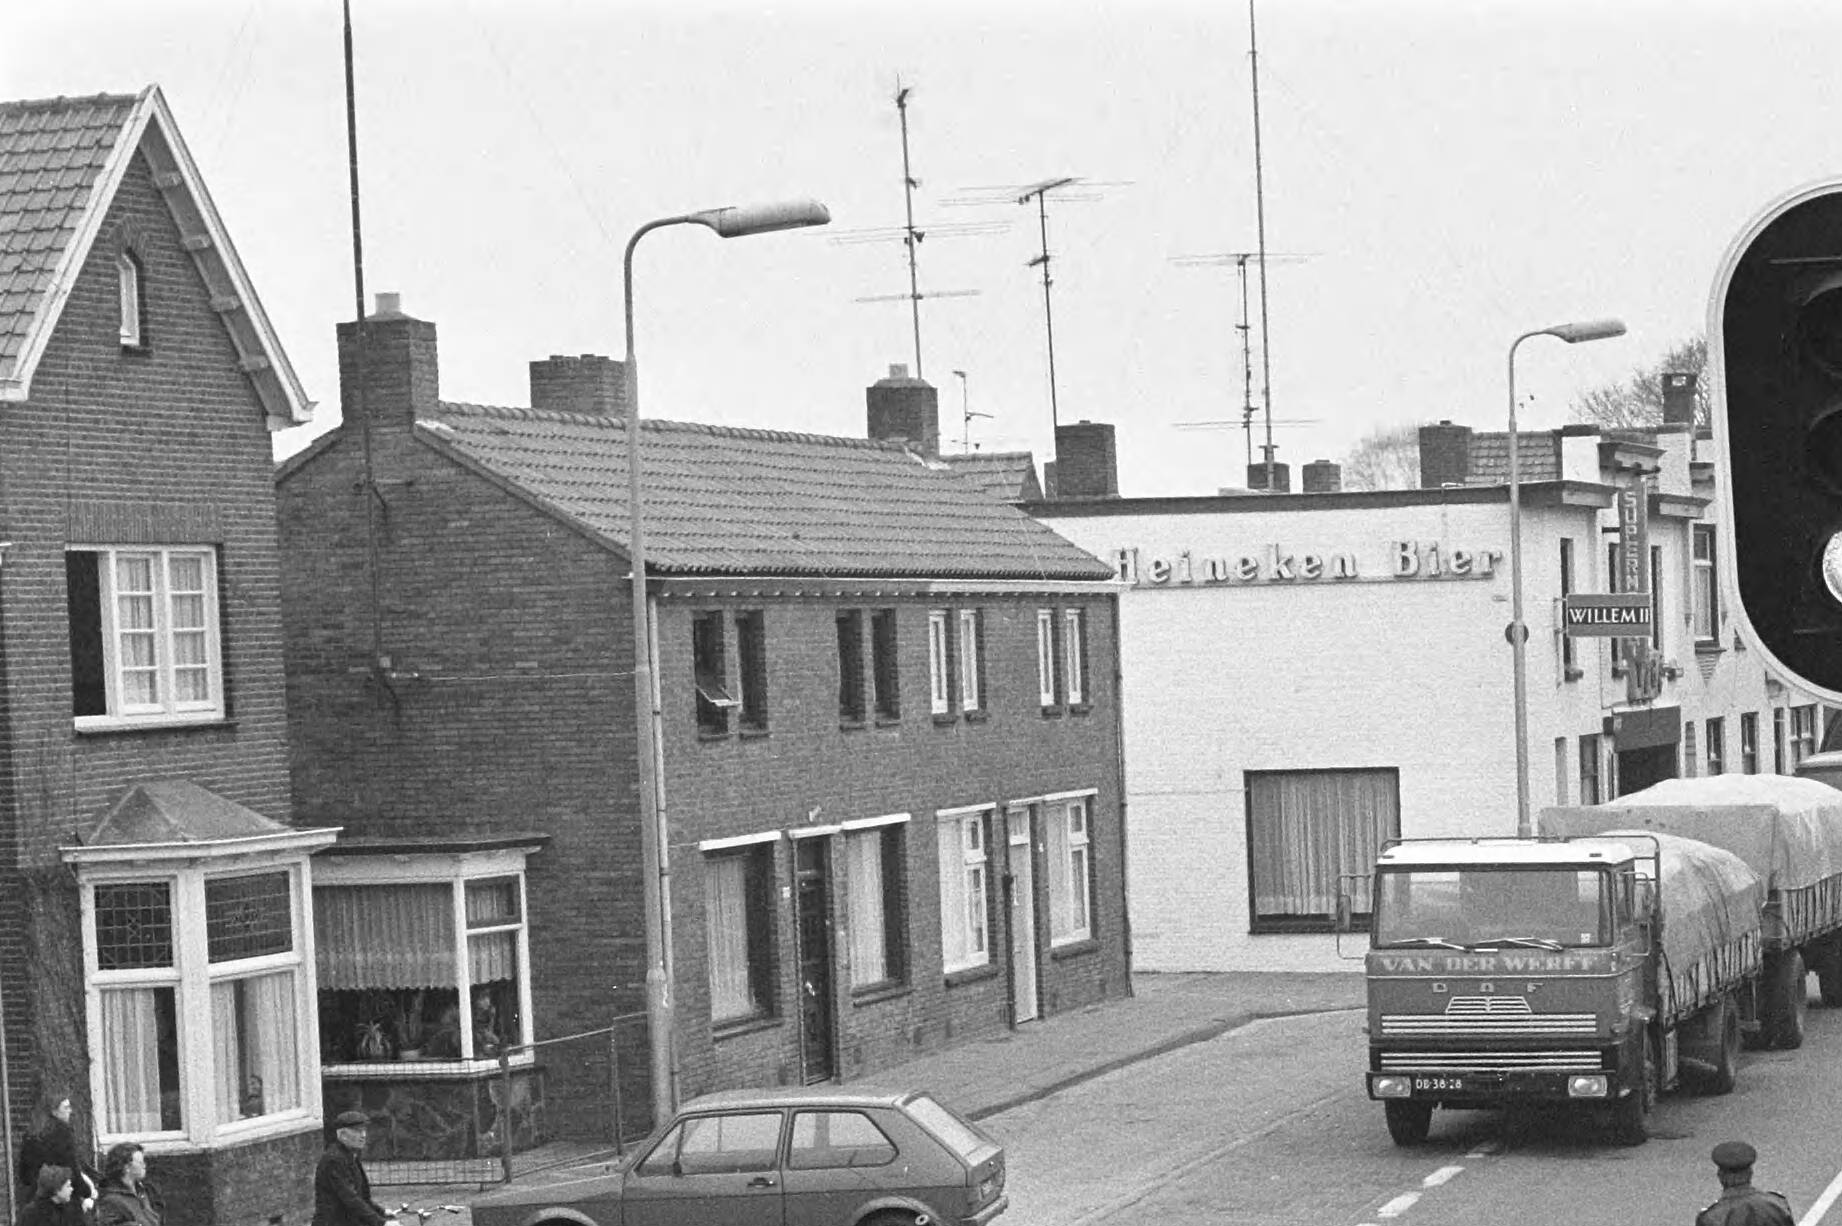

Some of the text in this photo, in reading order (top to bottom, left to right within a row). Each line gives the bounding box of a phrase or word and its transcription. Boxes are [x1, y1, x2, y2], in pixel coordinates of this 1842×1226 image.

[1116, 541, 1502, 585] Heineken Bier
[1569, 607, 1650, 624] WILLEM II
[1382, 956, 1433, 971] VAN
[1447, 956, 1496, 971] DER
